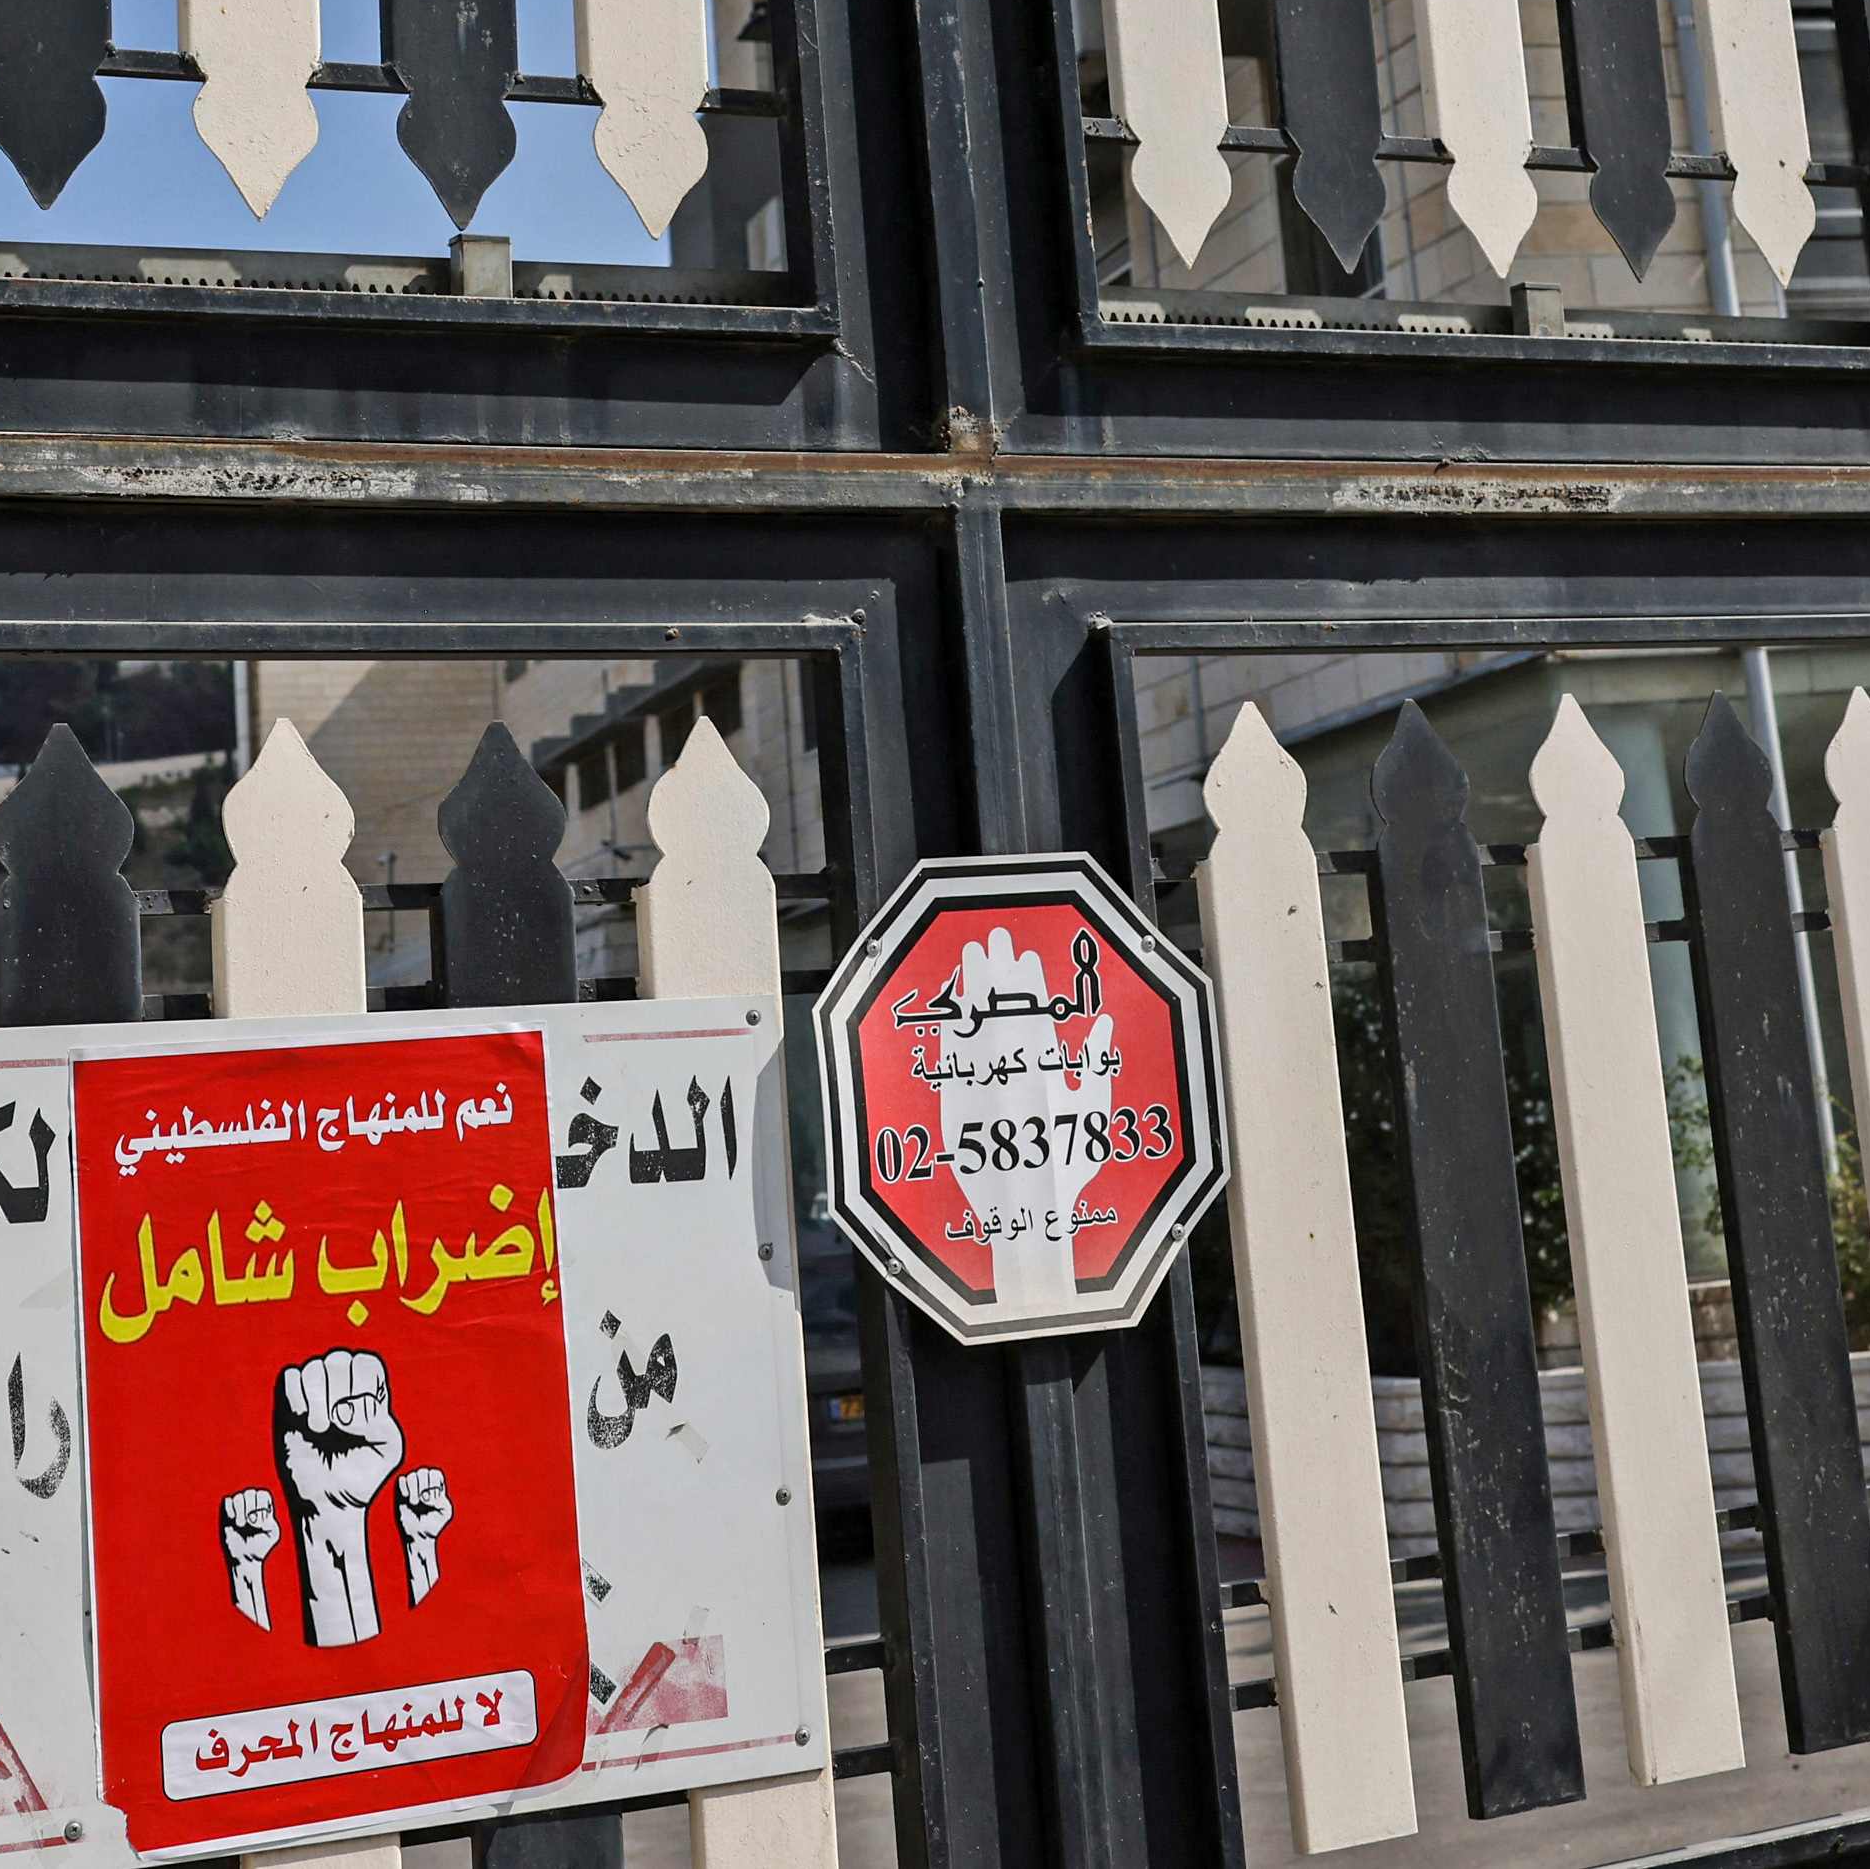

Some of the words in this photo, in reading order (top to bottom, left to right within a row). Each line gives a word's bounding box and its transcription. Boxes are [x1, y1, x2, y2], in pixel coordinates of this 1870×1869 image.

[892, 928, 1101, 1038] المصري
[911, 1046, 1027, 1090] كهربائية
[1037, 1039, 1121, 1078] بوابات
[114, 1096, 307, 1176] الفلسطيني
[317, 1088, 446, 1152] للمنهاج
[456, 1082, 514, 1142] نعم
[875, 1104, 1175, 1184] 02-5837833
[946, 1206, 1033, 1243] الوقوف
[1044, 1201, 1118, 1241] ممنوع
[99, 1199, 295, 1344] شامل
[317, 1183, 560, 1328] إضراب
[586, 1309, 679, 1451] من
[330, 1695, 465, 1763] للمنهاج
[475, 1687, 504, 1726] لا
[195, 1717, 319, 1778] المحرف
